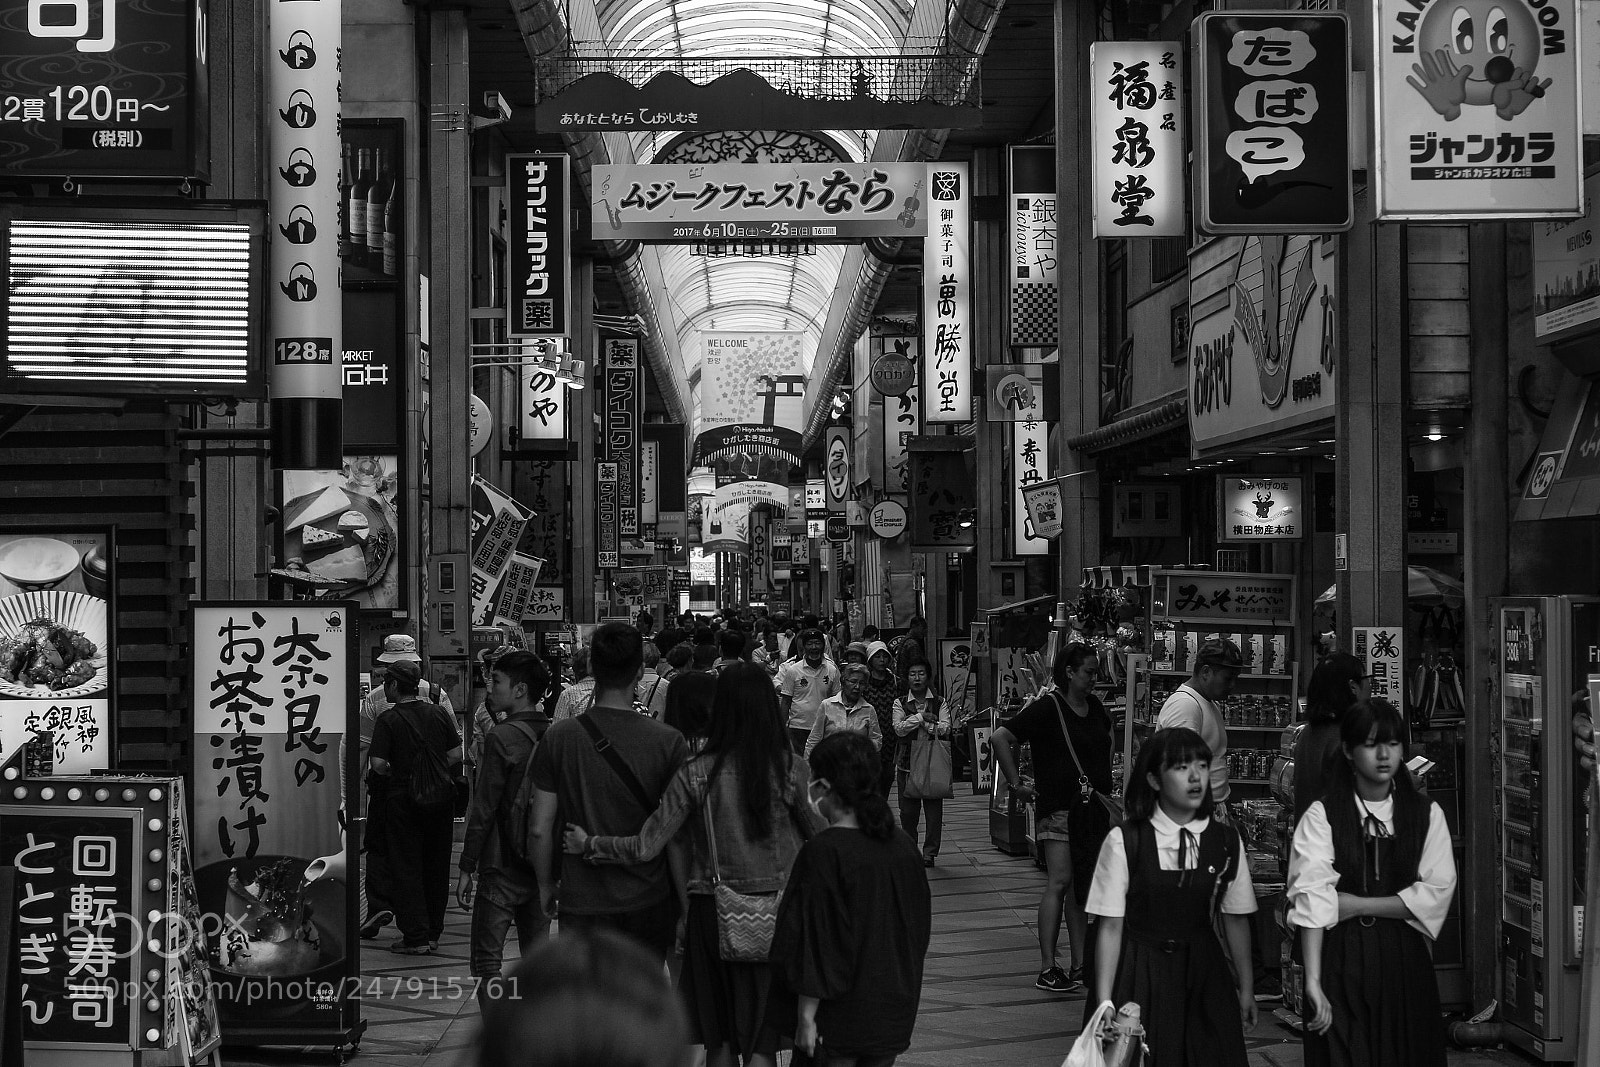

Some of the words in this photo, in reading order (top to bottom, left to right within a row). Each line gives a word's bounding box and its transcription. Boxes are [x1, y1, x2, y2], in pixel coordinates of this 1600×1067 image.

[1158, 51, 1177, 132] 名産品
[1242, 36, 1308, 165] たばこ
[91, 130, 143, 148] (税別)
[559, 112, 635, 126] あなたとなら
[638, 107, 699, 126] ひがしむき
[1108, 60, 1157, 226] 福泉堂
[1410, 132, 1555, 165] ジャンカラ
[620, 169, 895, 215] ムジークフェストなら
[525, 161, 550, 297] サンドラッグ
[940, 208, 954, 268] 御菓子司
[1015, 211, 1027, 265] ichouya
[1032, 198, 1057, 278] 銀杏や
[525, 302, 552, 328] 薬
[277, 342, 330, 362] 128席
[611, 341, 634, 367] 薬
[707, 339, 748, 348] WELCOME
[342, 364, 389, 386] 石井
[610, 371, 634, 450] ダイコク
[831, 449, 845, 495] ダイソー
[1238, 480, 1290, 491] おみやげの店
[601, 481, 616, 522] ダイコク
[1233, 525, 1294, 536] 横田物産本店
[1175, 584, 1231, 612] みそ
[1235, 595, 1283, 605] せんべい
[273, 616, 332, 786] 奈良の
[75, 706, 100, 754] 風神の
[210, 612, 274, 859] お茶漬け
[14, 832, 58, 1025] ととぎん
[69, 835, 117, 1028] 回転寿司
